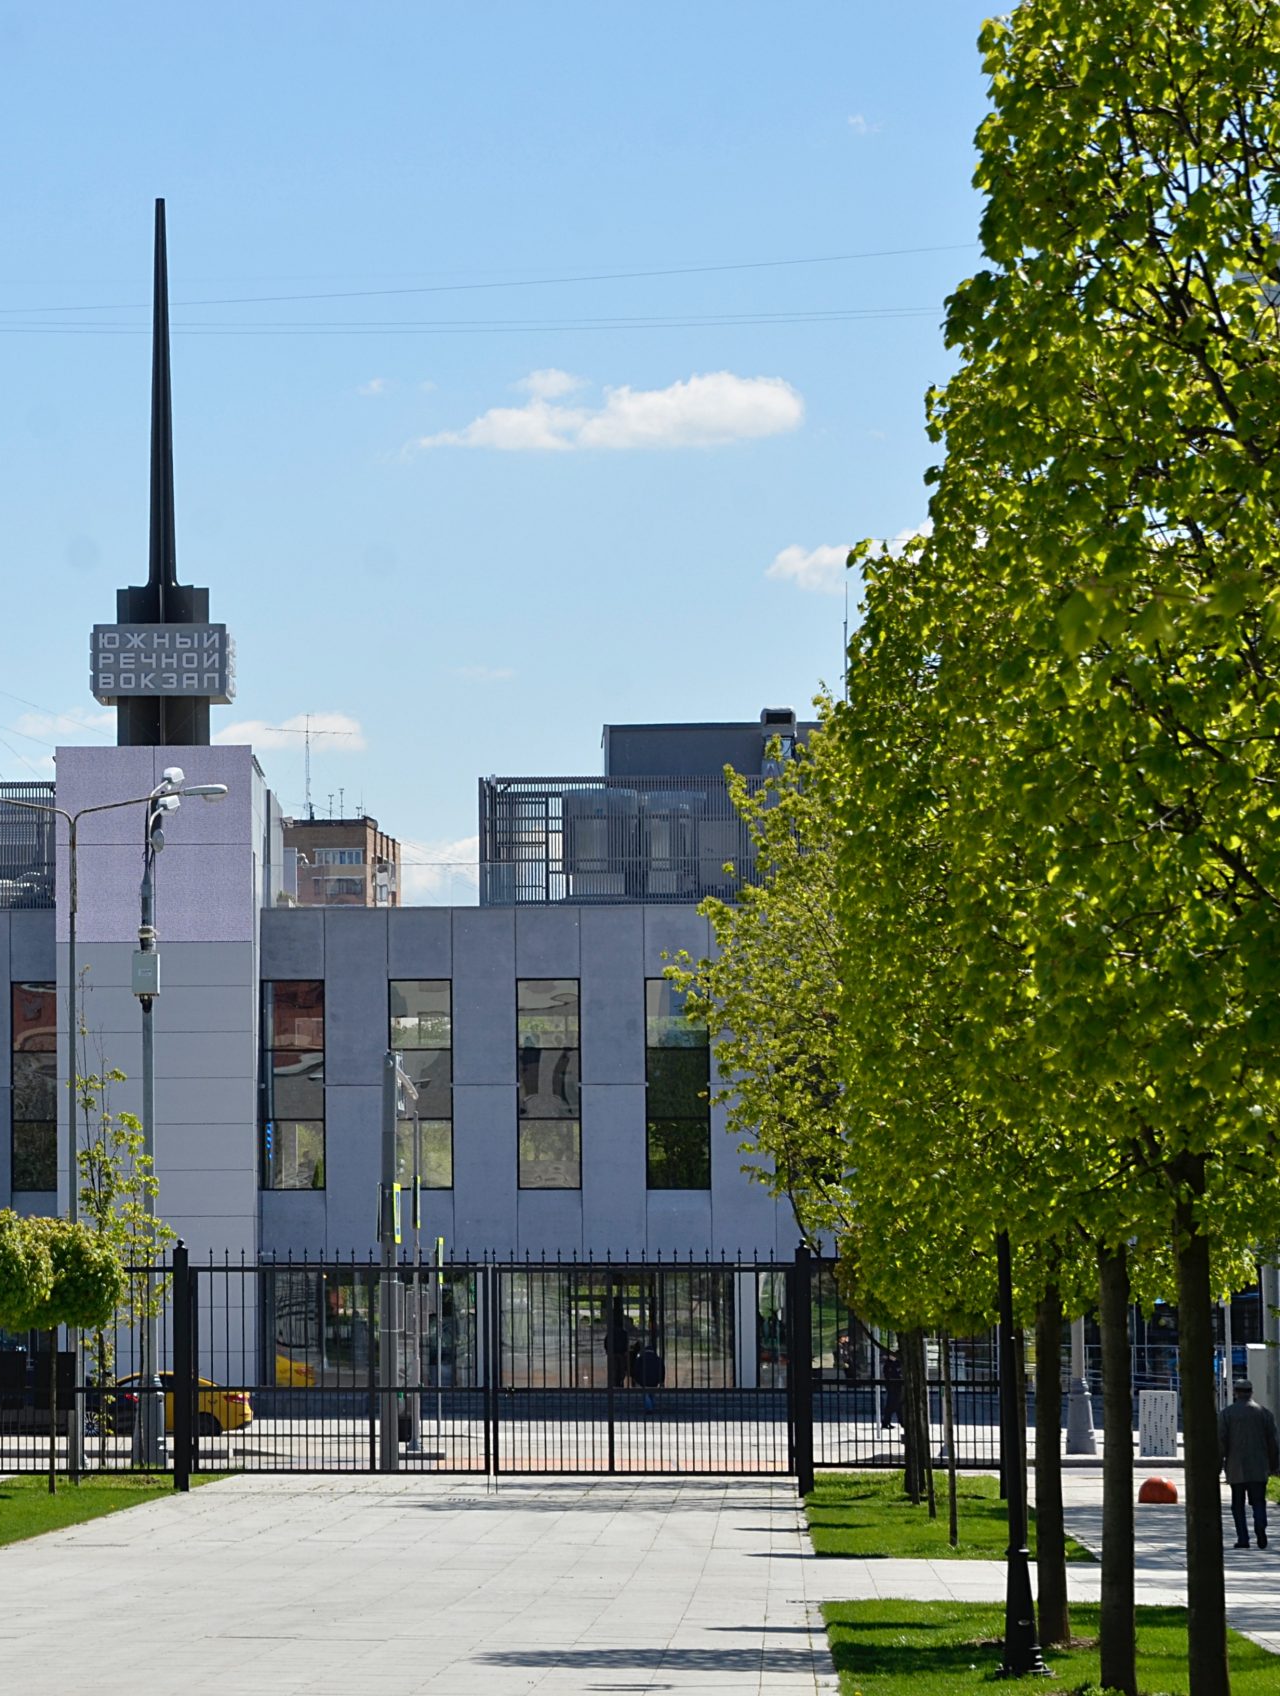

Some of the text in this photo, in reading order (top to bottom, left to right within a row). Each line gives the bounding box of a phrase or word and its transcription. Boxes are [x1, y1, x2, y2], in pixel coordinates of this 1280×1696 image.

[98, 630, 220, 649] ЮЖНЫЙ
[98, 650, 220, 669] РЕЧНОЙ
[98, 672, 220, 689] ВОКЗАЛ
